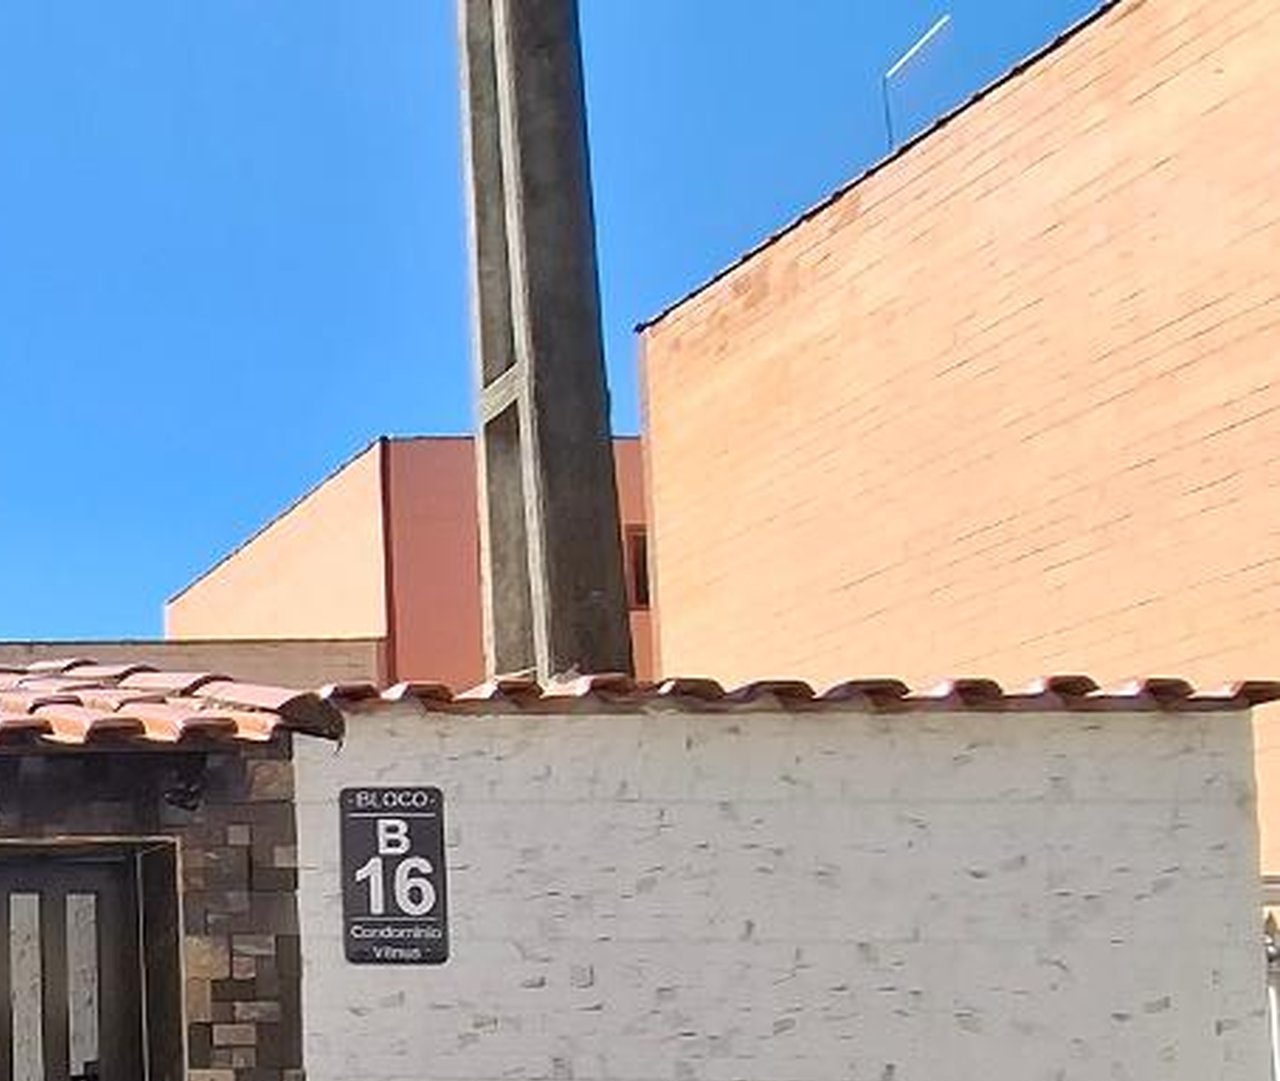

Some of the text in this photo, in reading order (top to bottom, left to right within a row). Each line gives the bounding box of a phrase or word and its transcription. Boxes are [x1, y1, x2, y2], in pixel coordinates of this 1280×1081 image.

[355, 791, 428, 808] BLOCO
[377, 819, 411, 854] B
[355, 857, 436, 916] 16
